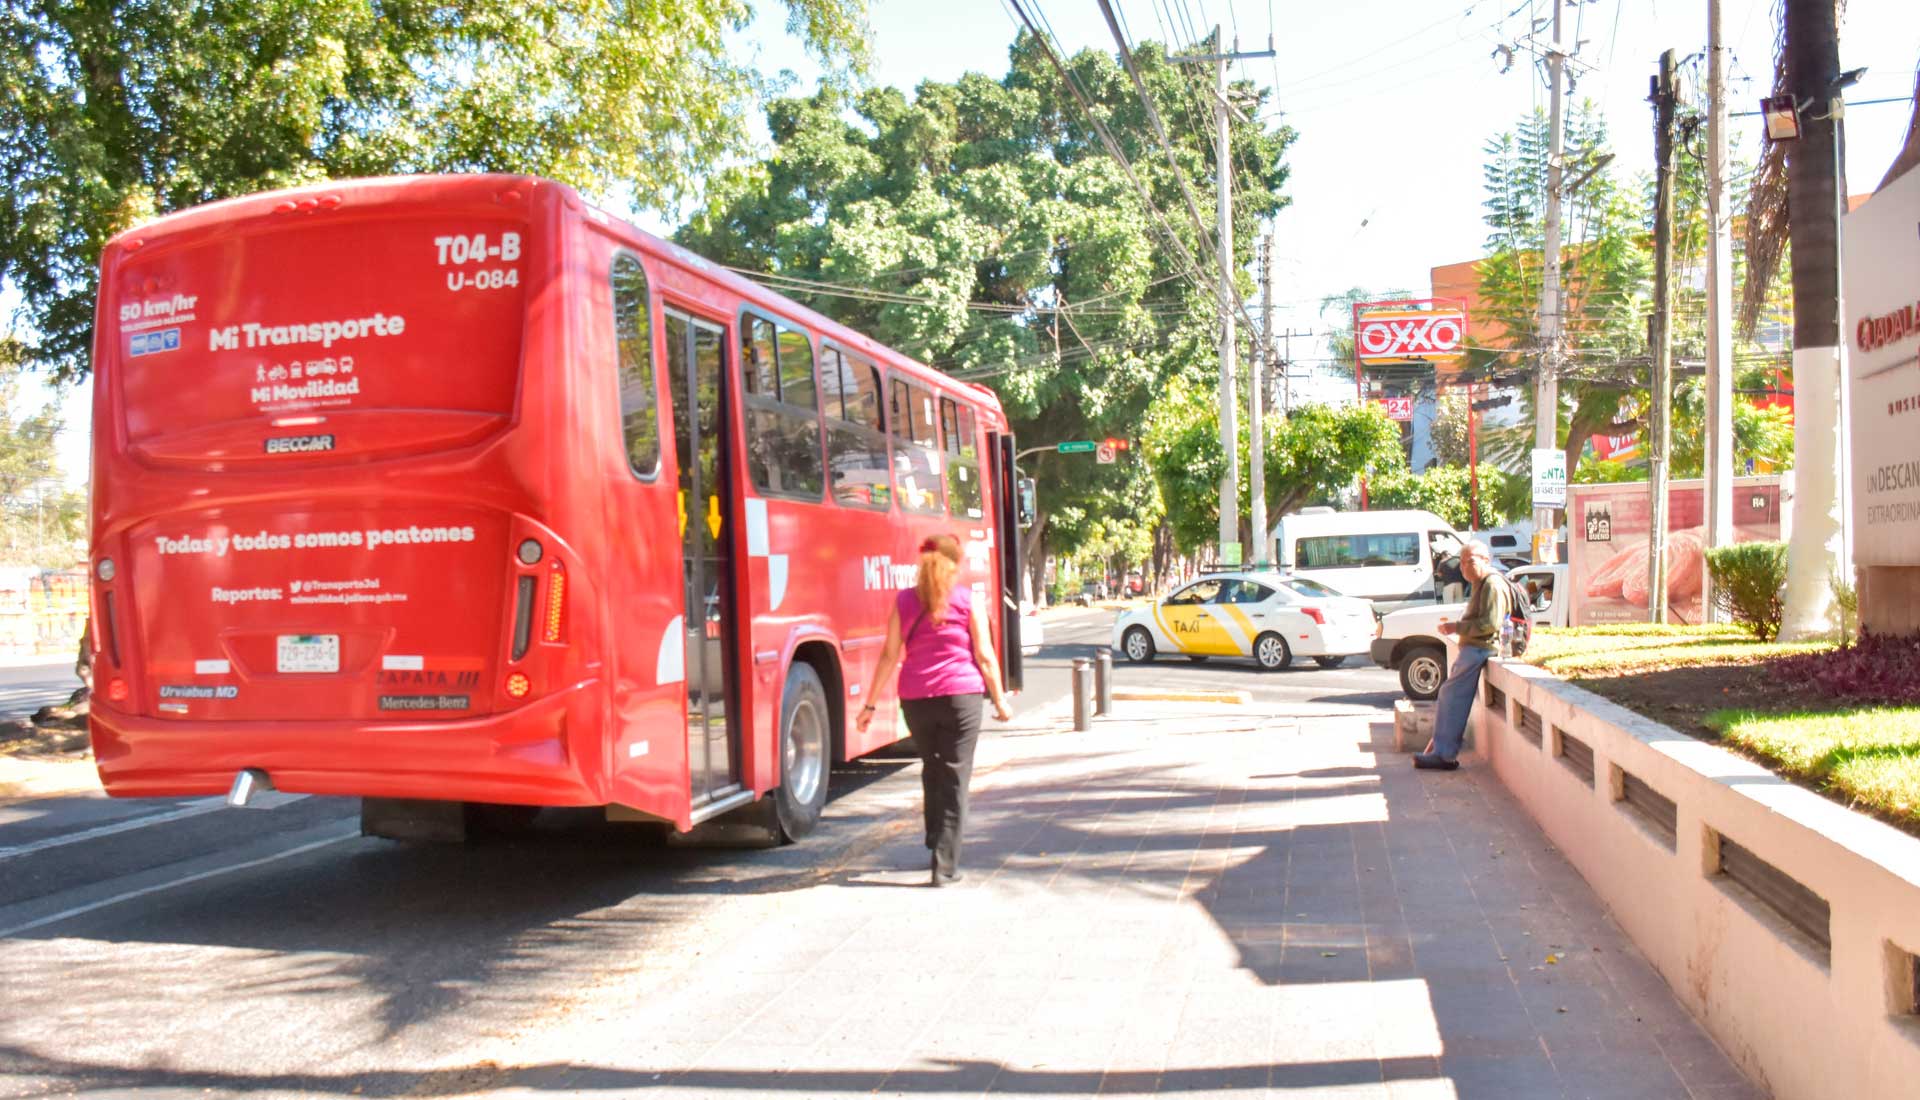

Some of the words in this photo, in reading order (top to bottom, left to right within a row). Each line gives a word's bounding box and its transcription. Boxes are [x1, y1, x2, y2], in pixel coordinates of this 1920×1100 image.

[434, 231, 521, 265] T04-B
[446, 268, 519, 291] U-084
[119, 302, 142, 321] 50
[143, 294, 198, 317] km/hr
[209, 327, 239, 352] Mi
[241, 313, 405, 348] Transporte
[1361, 319, 1461, 354] OXXO
[251, 387, 271, 403] Mi
[273, 378, 360, 400] Movilidad
[1390, 401, 1409, 413] 24
[266, 435, 333, 453] BECCAR
[155, 534, 213, 555] Todas
[215, 537, 229, 557] y
[232, 530, 291, 551] todos
[294, 531, 363, 548] somos
[365, 525, 475, 550] peatones
[863, 556, 881, 590] Mi
[211, 586, 283, 605] Reportes:
[377, 670, 448, 687] ZAPATA
[160, 685, 215, 698] Urviabus
[215, 685, 238, 698] MD
[381, 696, 468, 710] Mercedes-Benz
